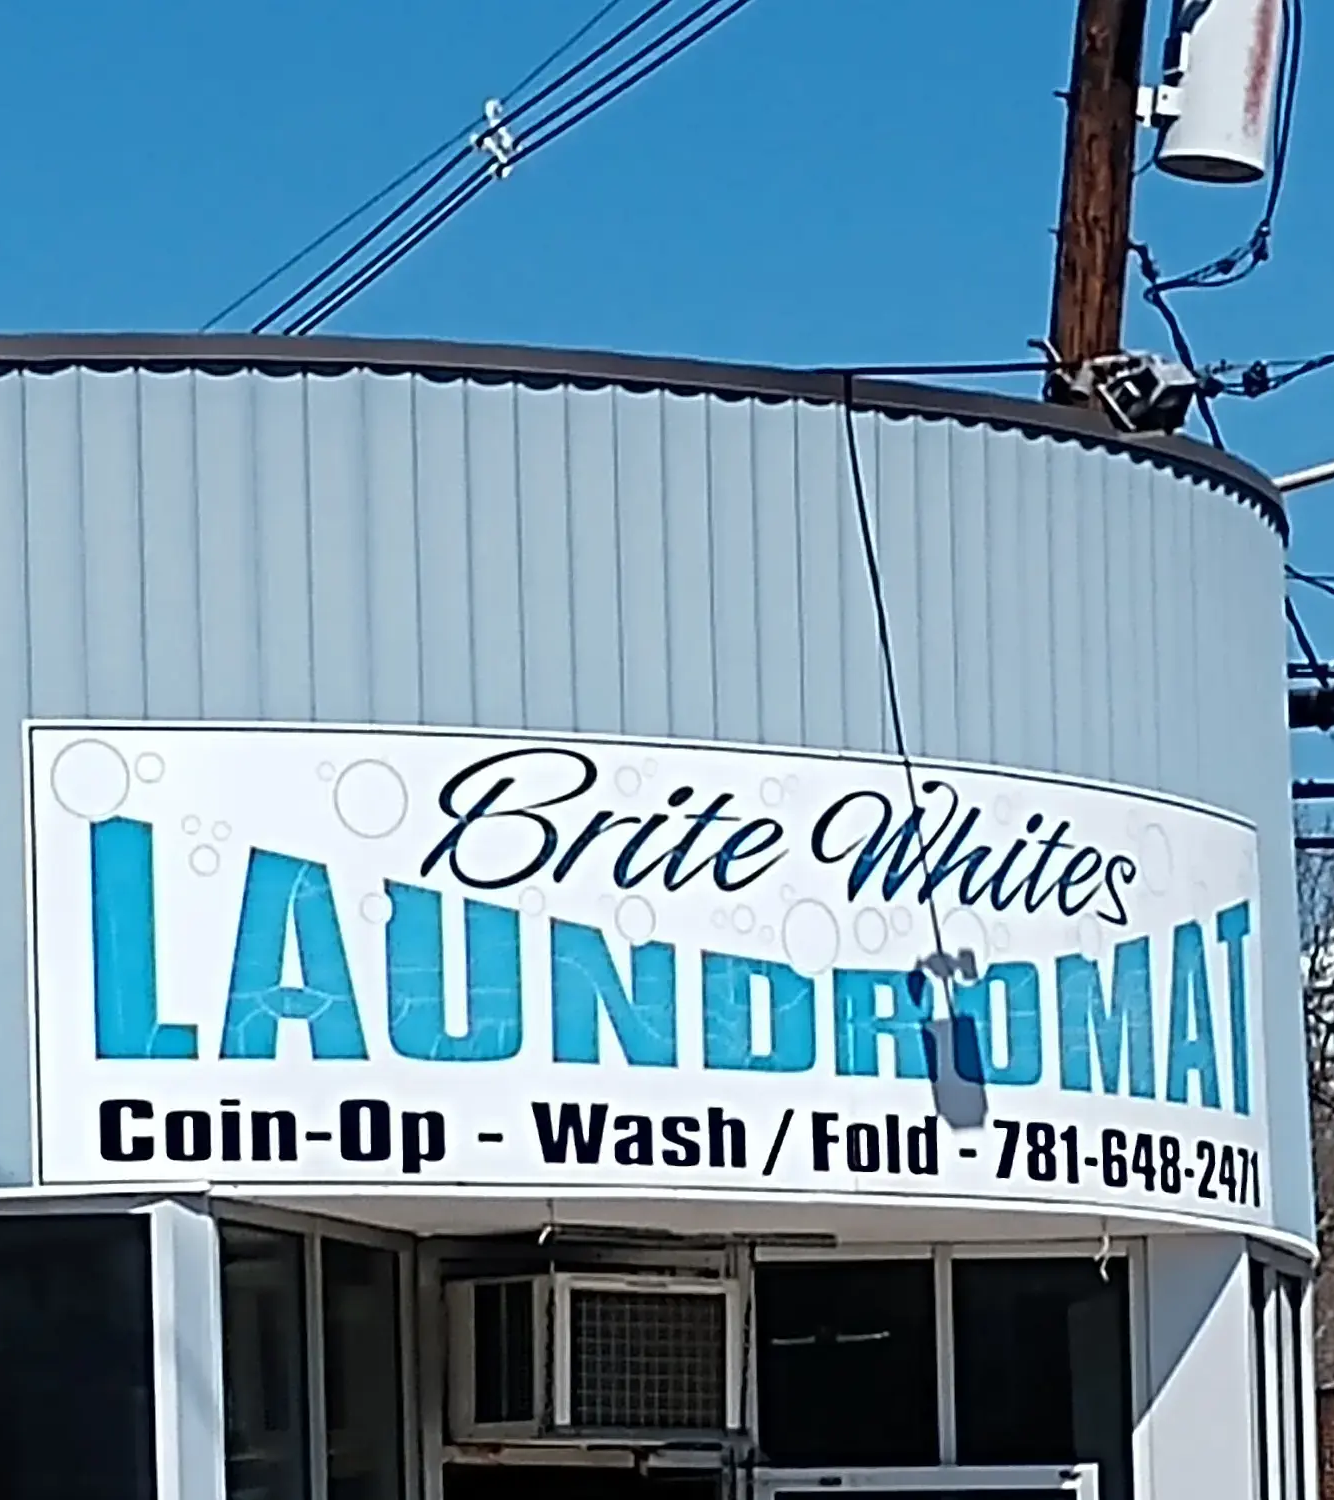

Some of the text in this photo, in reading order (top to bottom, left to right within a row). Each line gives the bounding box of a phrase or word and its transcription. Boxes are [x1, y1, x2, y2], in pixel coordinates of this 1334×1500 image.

[420, 747, 1136, 925] Brite Whites
[89, 815, 1251, 1116] LAUNDROMAT
[99, 1098, 446, 1173] Coin-Op
[532, 1101, 746, 1169] Wash
[811, 1111, 939, 1176] Fold
[993, 1118, 1261, 1208] 781-648-2471
